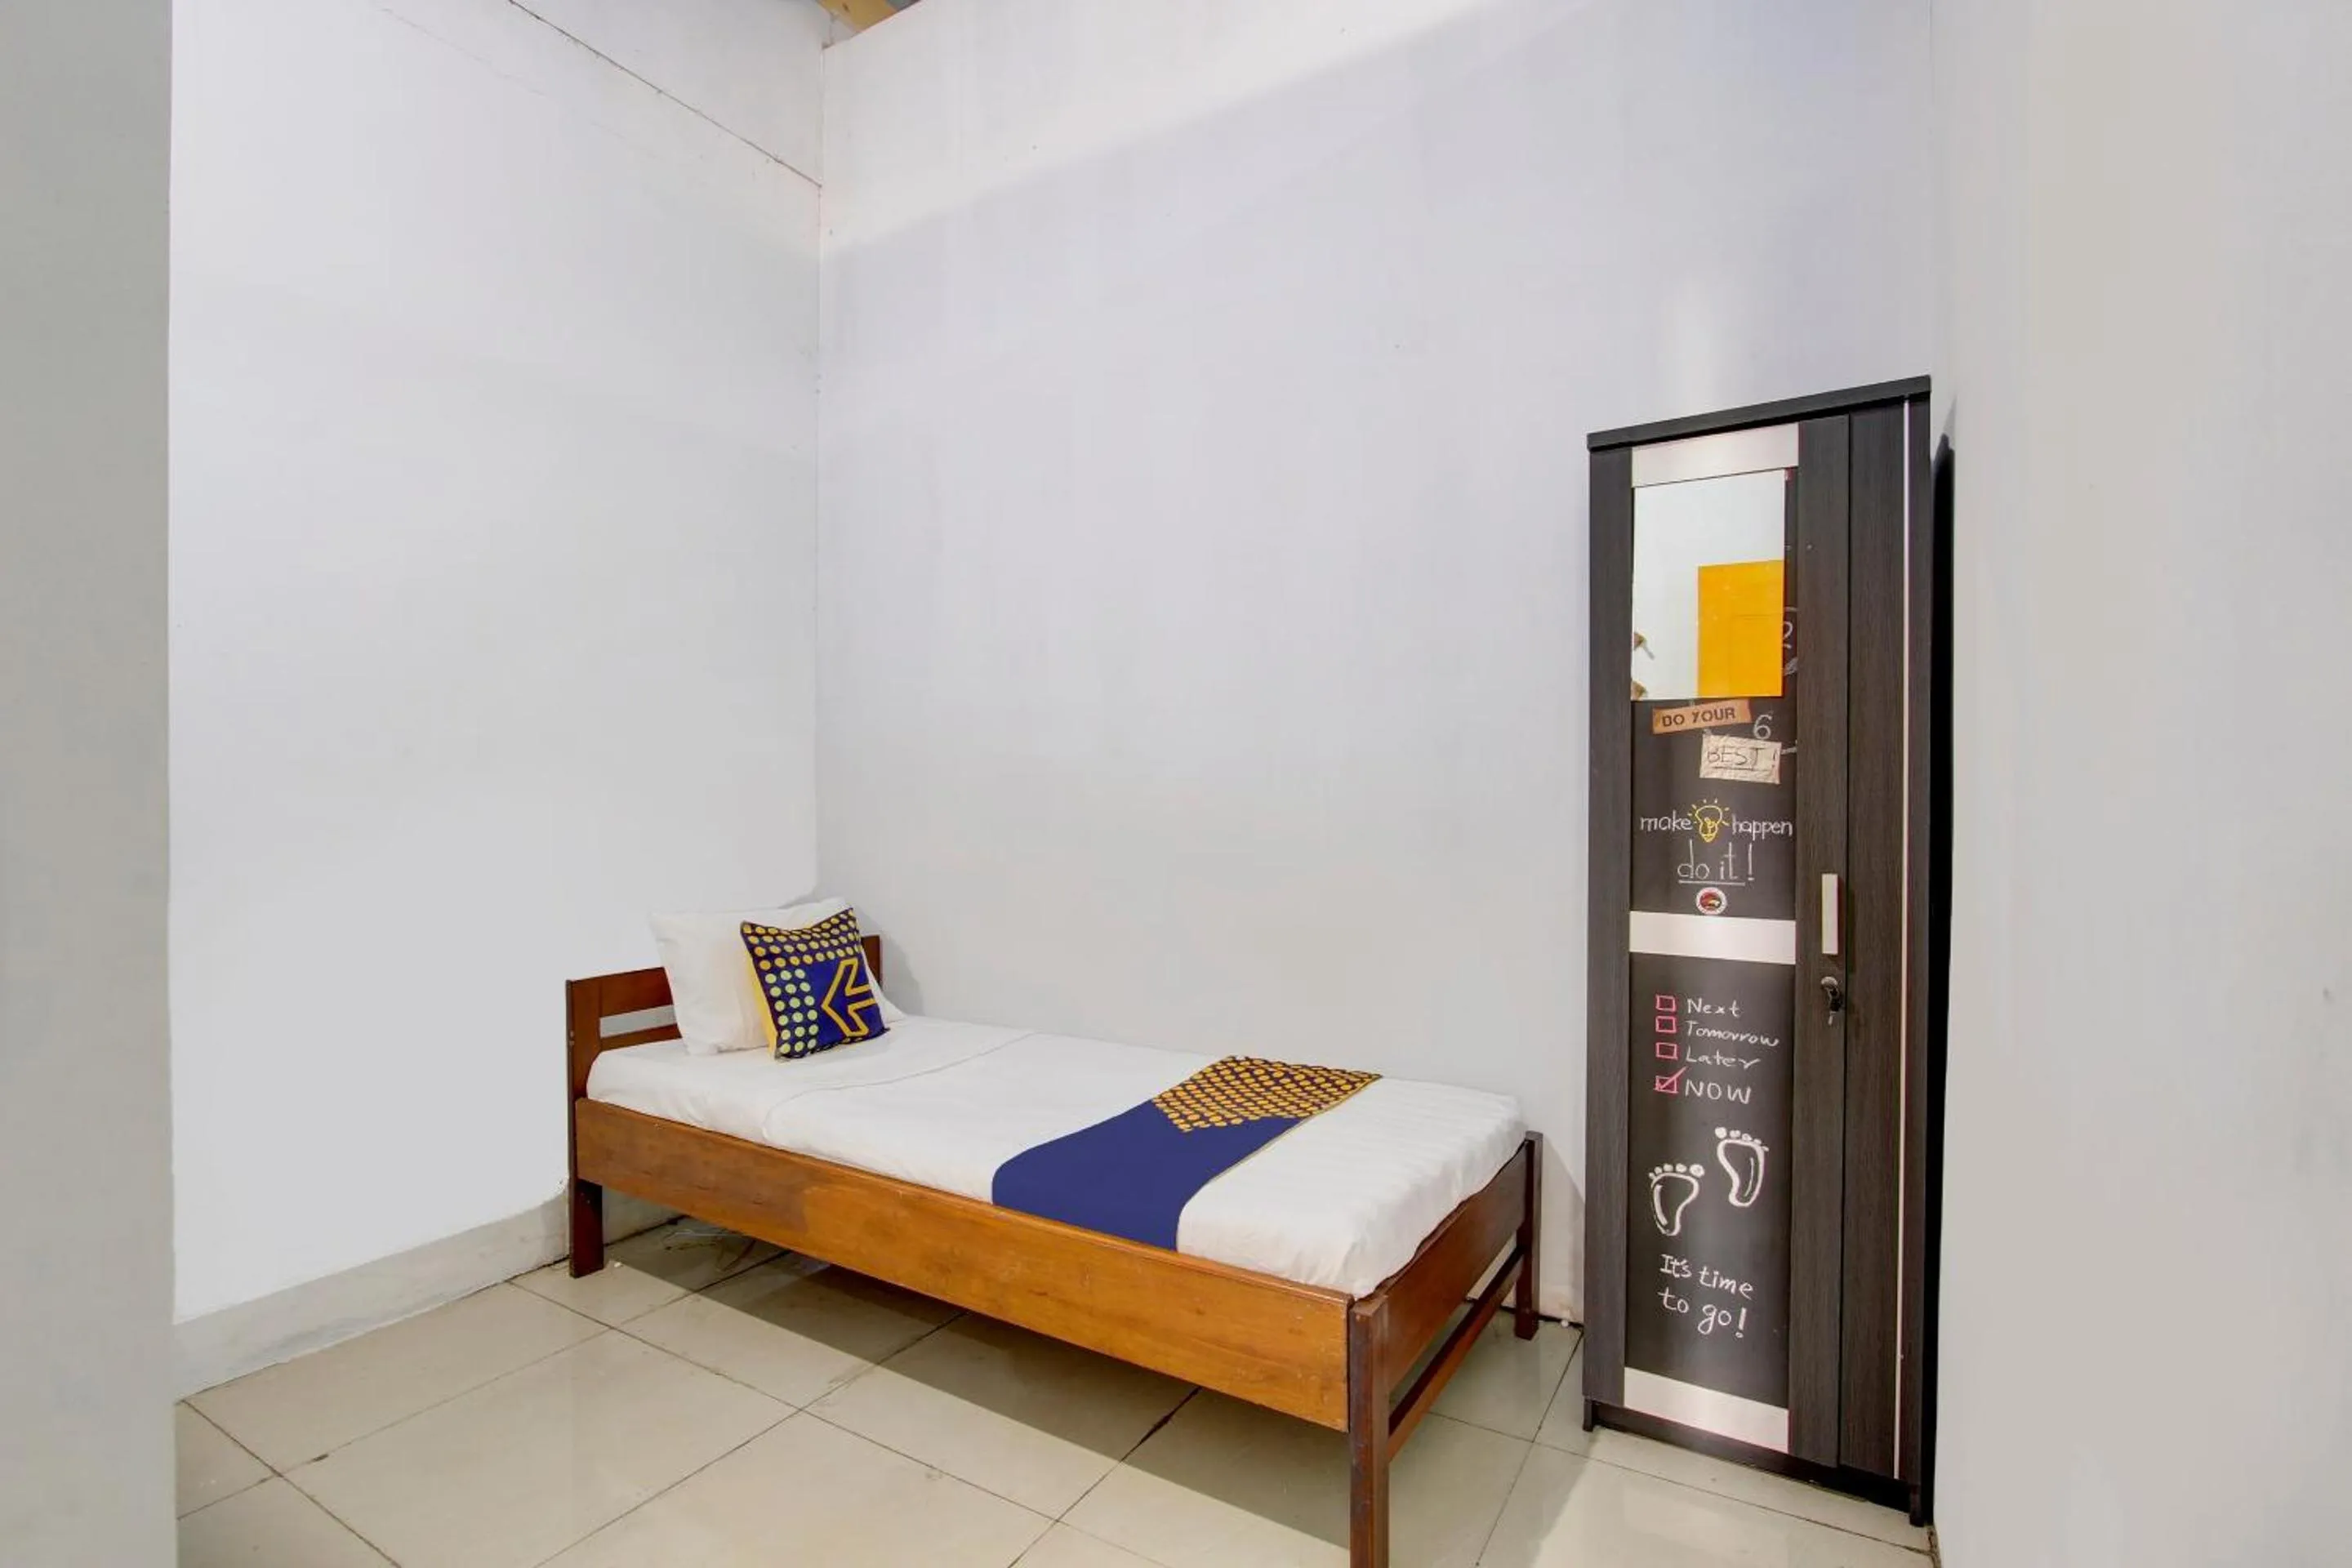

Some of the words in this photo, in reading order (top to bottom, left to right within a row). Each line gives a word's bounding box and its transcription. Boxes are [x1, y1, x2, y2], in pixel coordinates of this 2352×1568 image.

[1662, 713, 1685, 727] DO
[1692, 708, 1735, 724] YOUR
[1753, 714, 1772, 740] 6
[1640, 809, 1693, 831] make
[1732, 814, 1793, 840] happen
[1677, 839, 1710, 880] do
[1686, 997, 1741, 1018] Next
[1686, 1020, 1780, 1047] Tomorrow
[1686, 1045, 1761, 1070] Later
[1685, 1078, 1752, 1104] NOW
[1659, 1254, 1692, 1278] It's
[1699, 1266, 1754, 1300] time
[1658, 1287, 1689, 1313] to
[1698, 1304, 1747, 1339] go!
